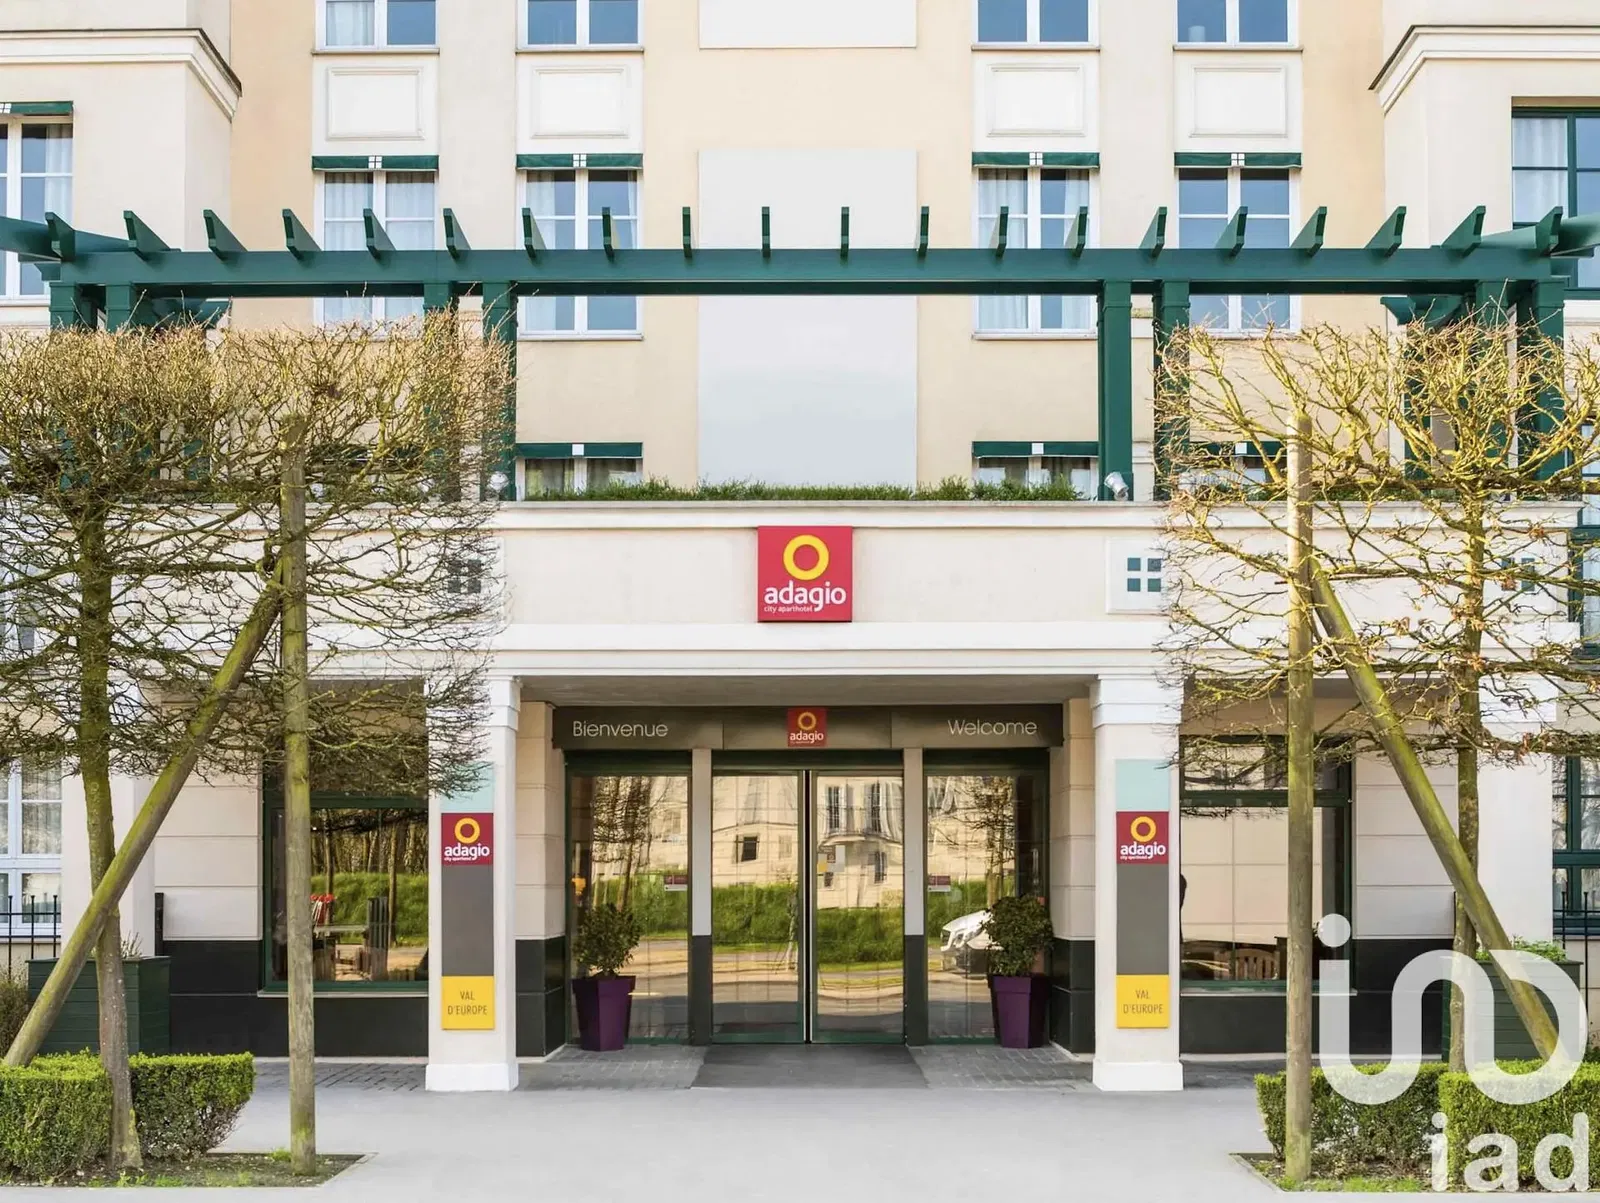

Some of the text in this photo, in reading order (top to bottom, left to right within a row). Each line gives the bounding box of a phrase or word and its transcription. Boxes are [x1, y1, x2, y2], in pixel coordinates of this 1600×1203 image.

[764, 580, 847, 612] adagio
[764, 604, 813, 614] city aparthotel
[572, 720, 669, 738] Bienvenue
[947, 718, 1038, 735] Welcome
[789, 730, 824, 744] adagio
[444, 842, 490, 861] adagio
[1120, 841, 1166, 860] adagio
[459, 990, 476, 1001] VAL
[1135, 989, 1151, 1000] VAL
[447, 1004, 488, 1016] D'EUROPE
[1123, 1003, 1164, 1015] D'EUROPE
